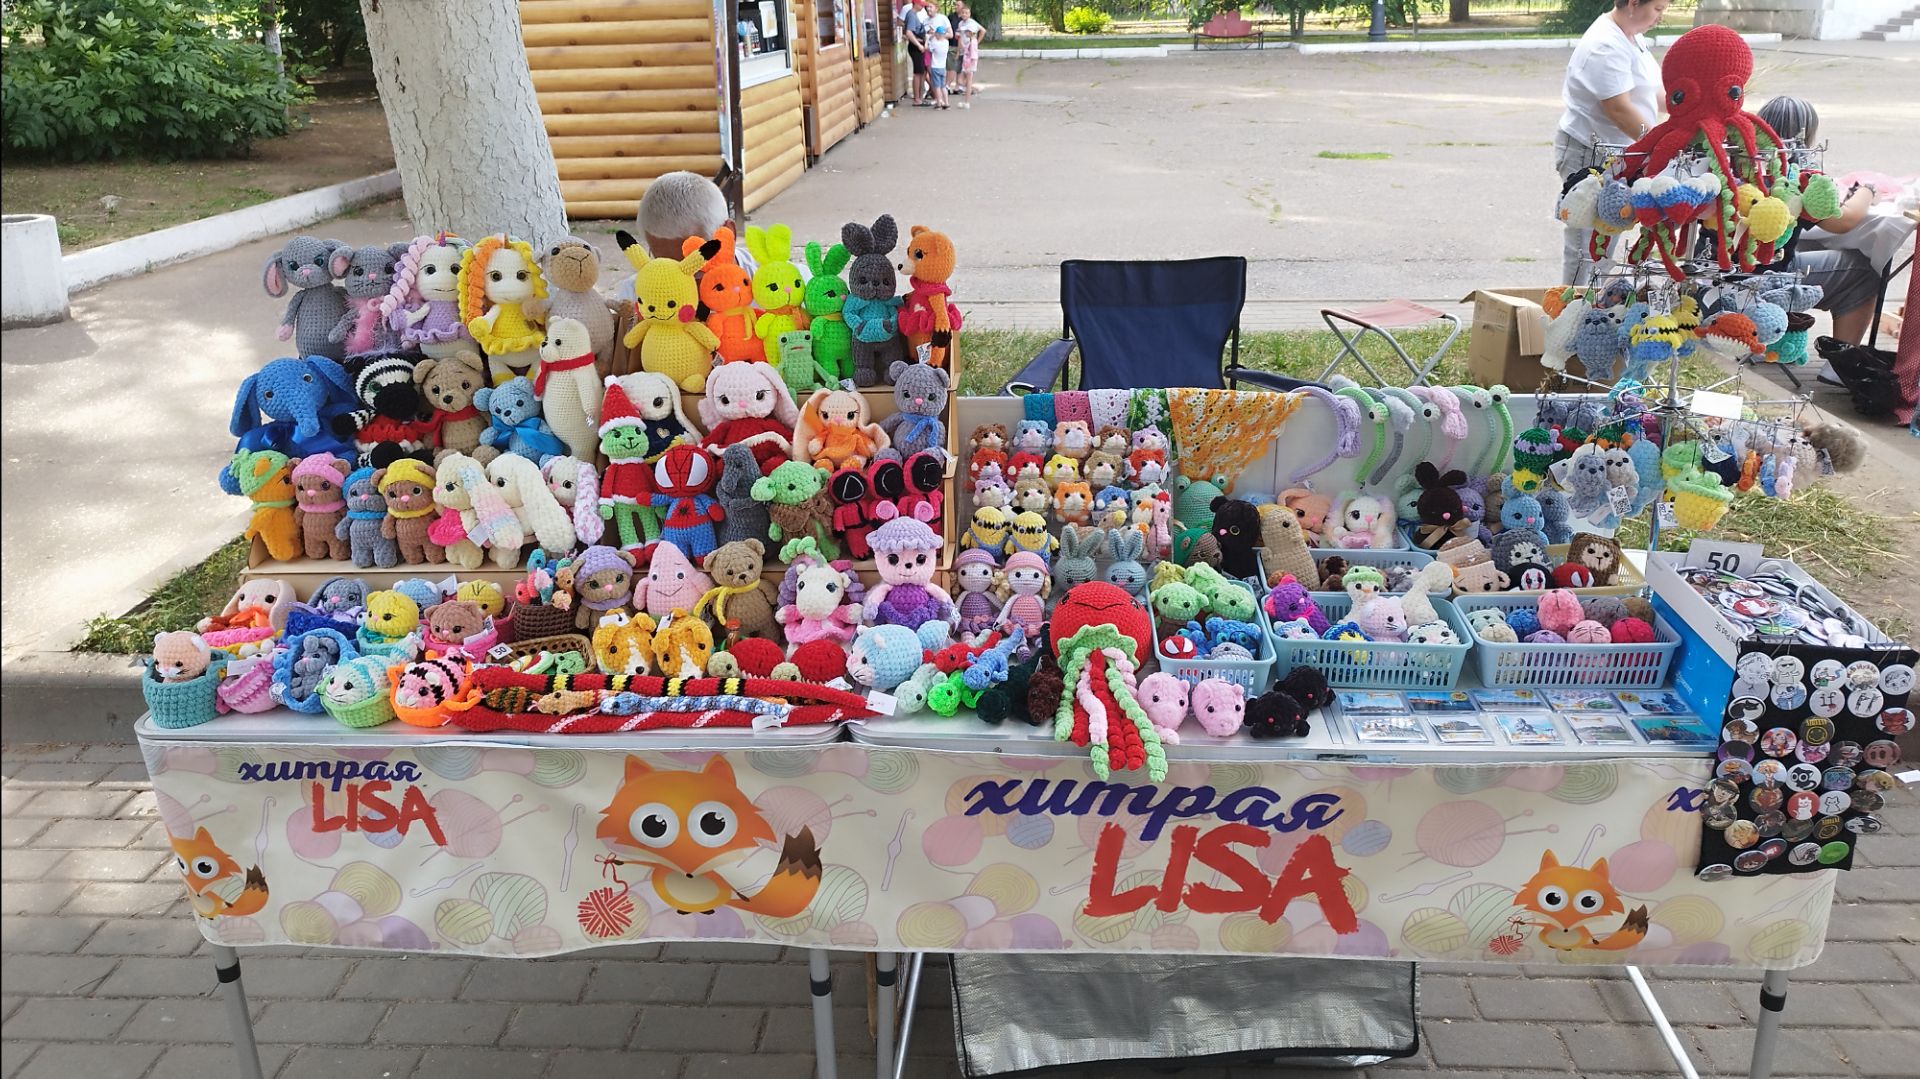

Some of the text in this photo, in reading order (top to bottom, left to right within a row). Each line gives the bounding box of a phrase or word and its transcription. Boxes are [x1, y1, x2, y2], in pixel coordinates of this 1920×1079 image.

[1705, 551, 1740, 574] 50
[494, 646, 507, 656] 50
[238, 760, 422, 792] хитрая
[311, 779, 449, 847] LISA
[963, 778, 1345, 842] хитрая
[1082, 821, 1360, 935] LISA
